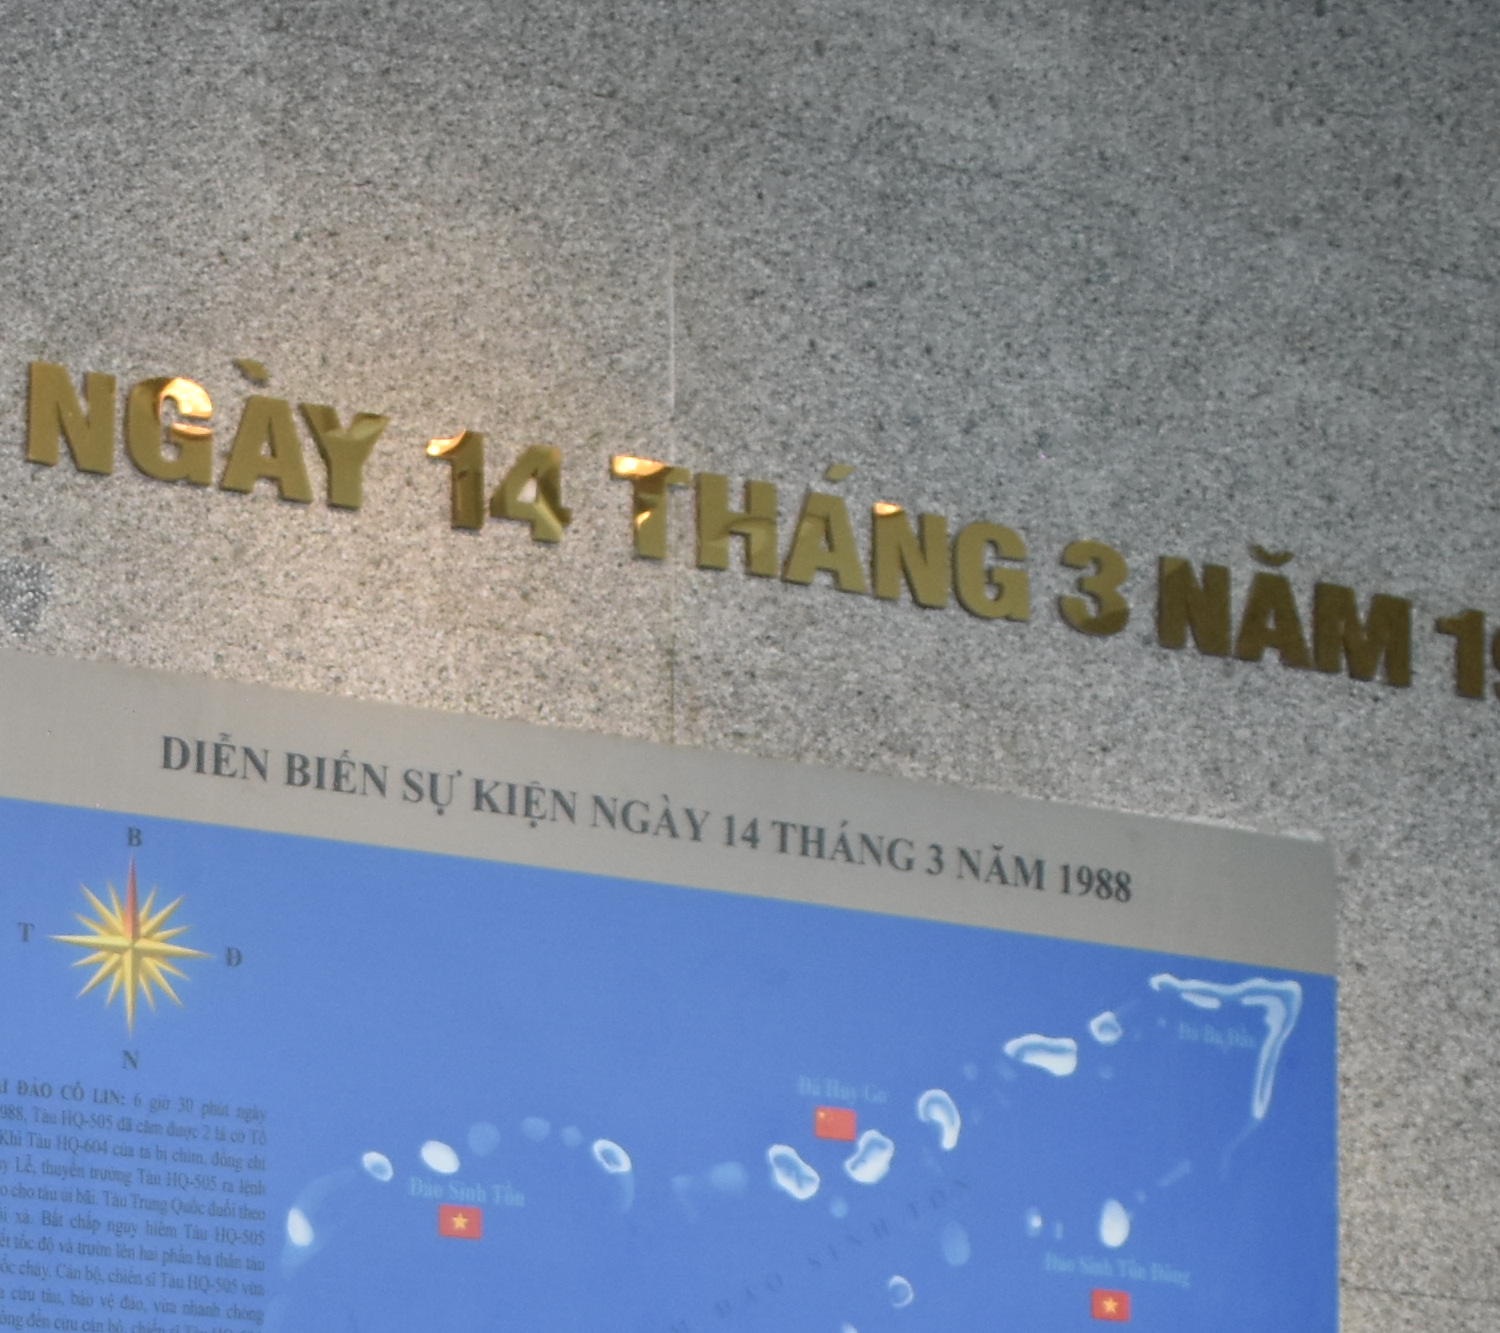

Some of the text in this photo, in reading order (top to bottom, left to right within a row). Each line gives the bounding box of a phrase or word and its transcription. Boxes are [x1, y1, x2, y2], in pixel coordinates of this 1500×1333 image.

[27, 358, 389, 511] NGÀY
[426, 429, 572, 543] 14
[611, 455, 1030, 623] THÁNG
[1056, 539, 1130, 635] 3
[1157, 544, 1411, 688] NĂM
[160, 727, 1132, 905] DIỄN BIẾN SỰ KIỆN NGÀY 14 THÁNG 3 NĂM 1988
[128, 827, 142, 846] B
[19, 922, 35, 942] T
[123, 1049, 138, 1069] N
